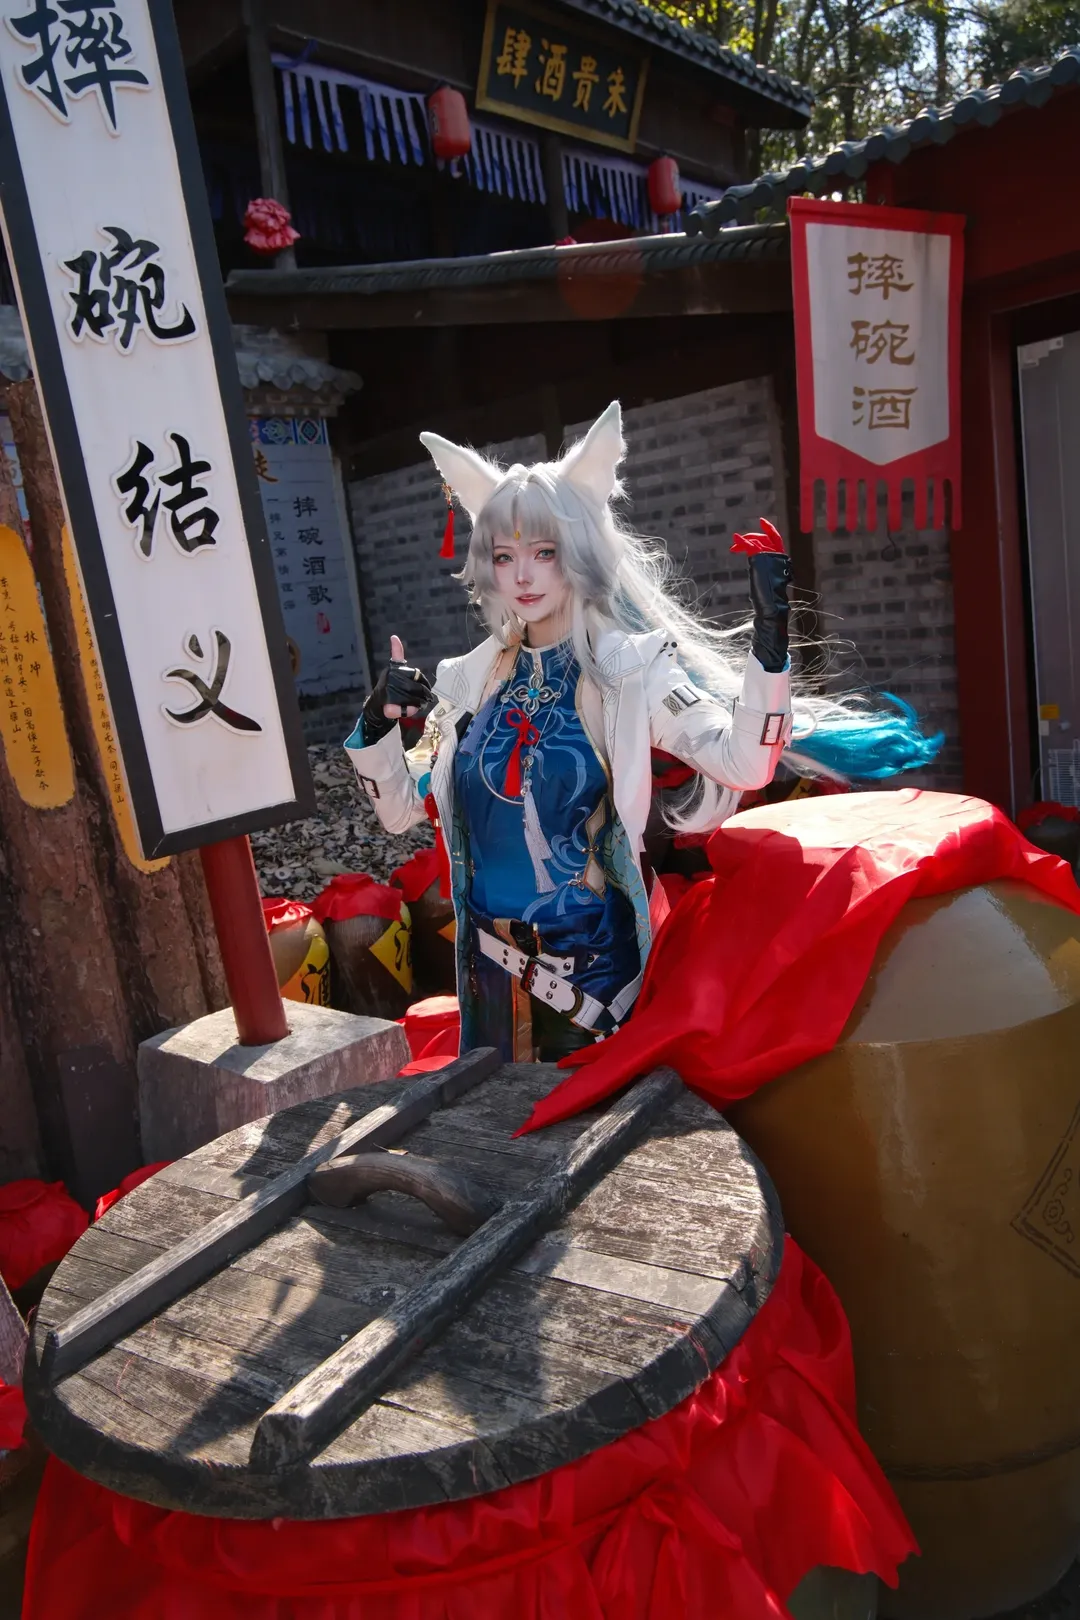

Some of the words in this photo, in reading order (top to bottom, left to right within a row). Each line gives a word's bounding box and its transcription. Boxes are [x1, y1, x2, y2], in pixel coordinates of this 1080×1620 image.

[9, 0, 263, 732] 摔碗结义
[847, 252, 919, 430] 摔碗酒
[293, 496, 333, 606] 摔碗酒歌
[24, 629, 41, 678] 林冲
